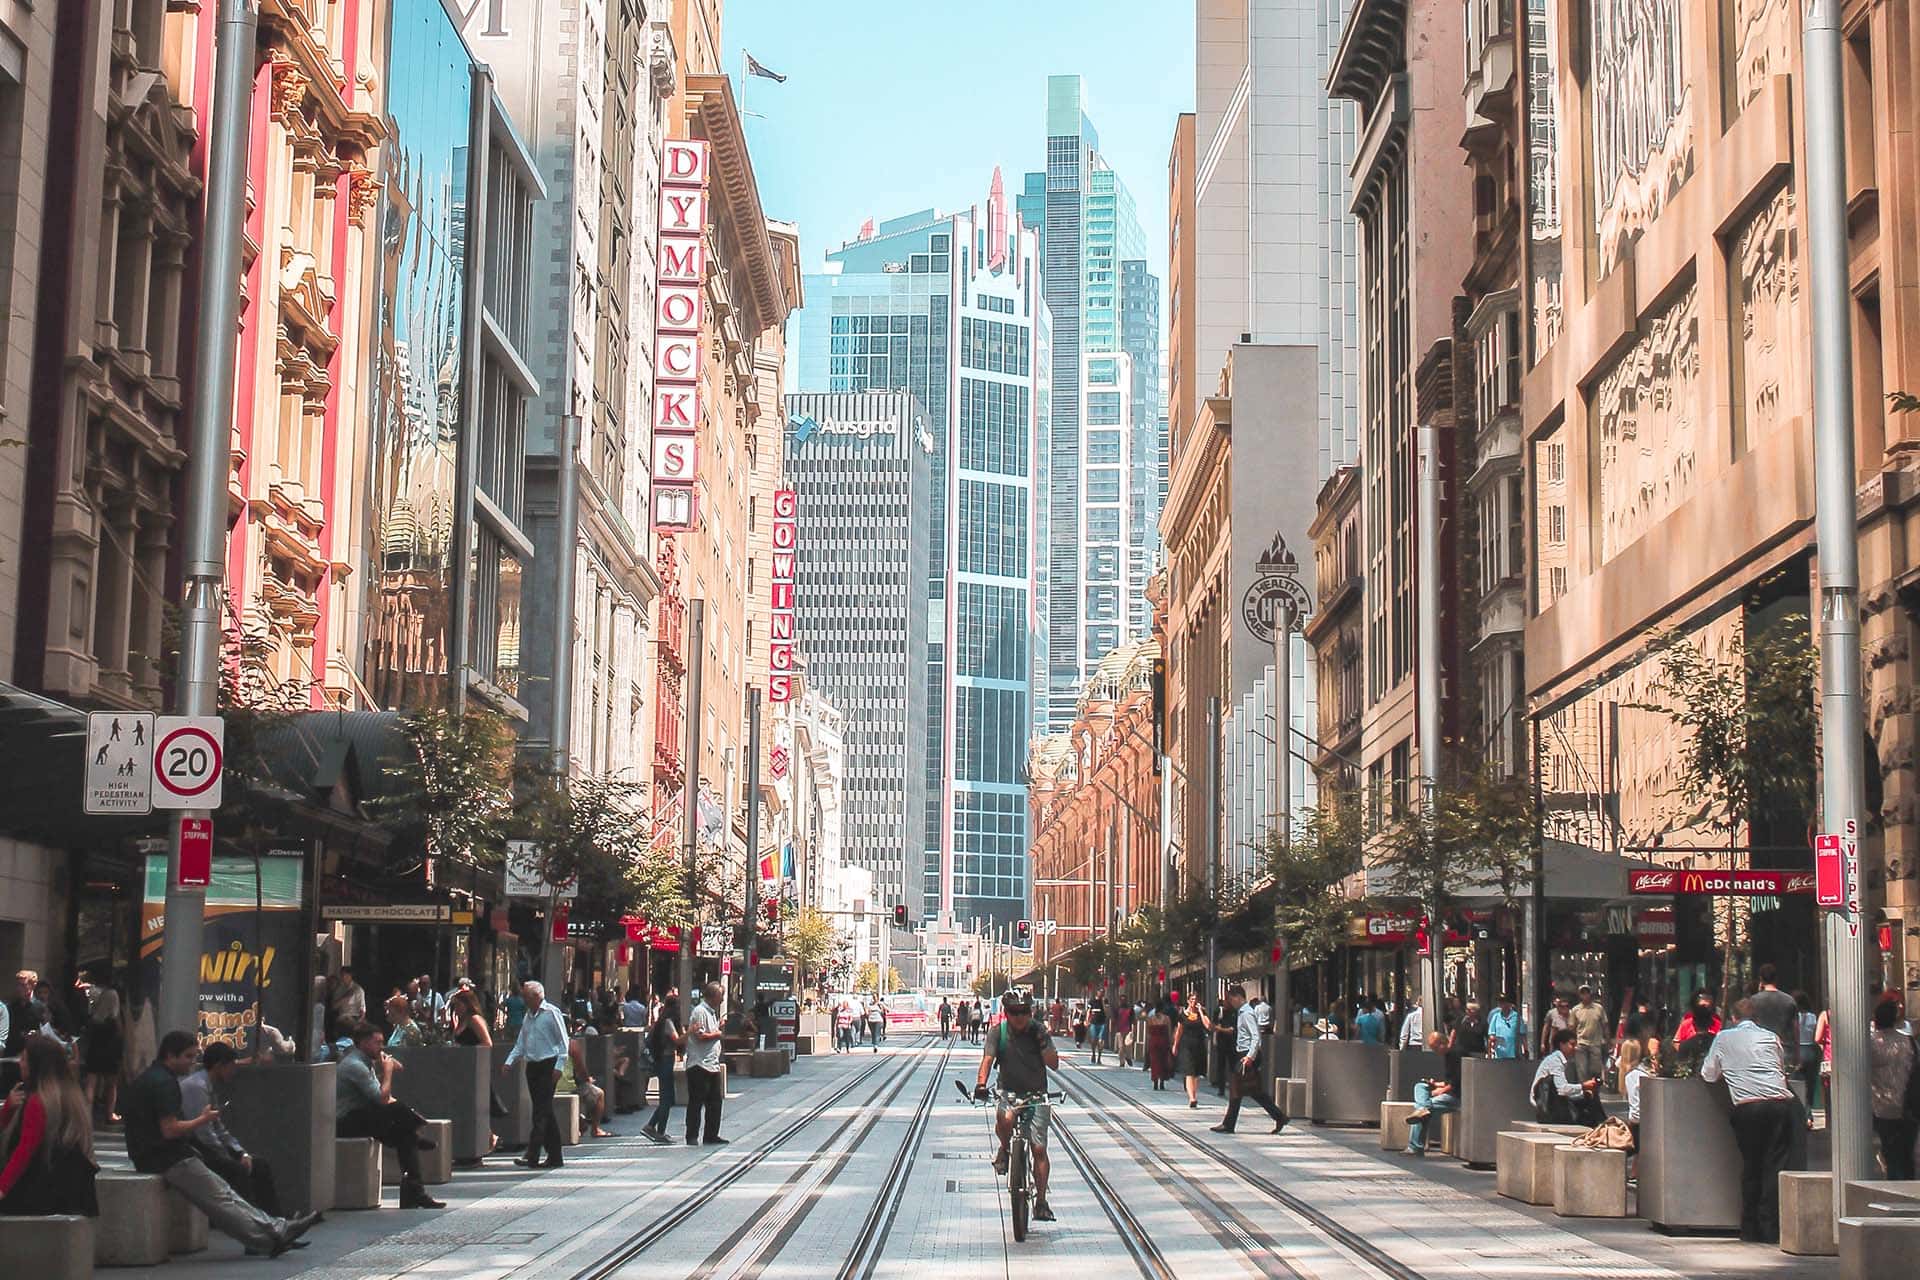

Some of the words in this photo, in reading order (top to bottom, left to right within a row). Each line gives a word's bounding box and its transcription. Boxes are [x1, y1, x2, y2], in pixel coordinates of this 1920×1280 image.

[660, 147, 698, 476] DYMOCKS
[819, 414, 897, 439] Ausgrid
[1255, 579, 1300, 594] HEALTH
[771, 494, 793, 700] GOWINGS
[1246, 609, 1270, 638] CARE
[168, 747, 208, 777] 20
[108, 782, 129, 790] HIGH
[94, 791, 145, 799] PEDESTRIAN
[100, 799, 138, 807] ACTIVITY
[192, 822, 201, 830] NO
[183, 831, 209, 840] STOPPING
[1823, 838, 1832, 847] NO
[1818, 848, 1838, 857] STOPPING
[327, 907, 370, 916] HAIGH'S
[199, 993, 213, 1001] ow
[215, 992, 237, 1002] with
